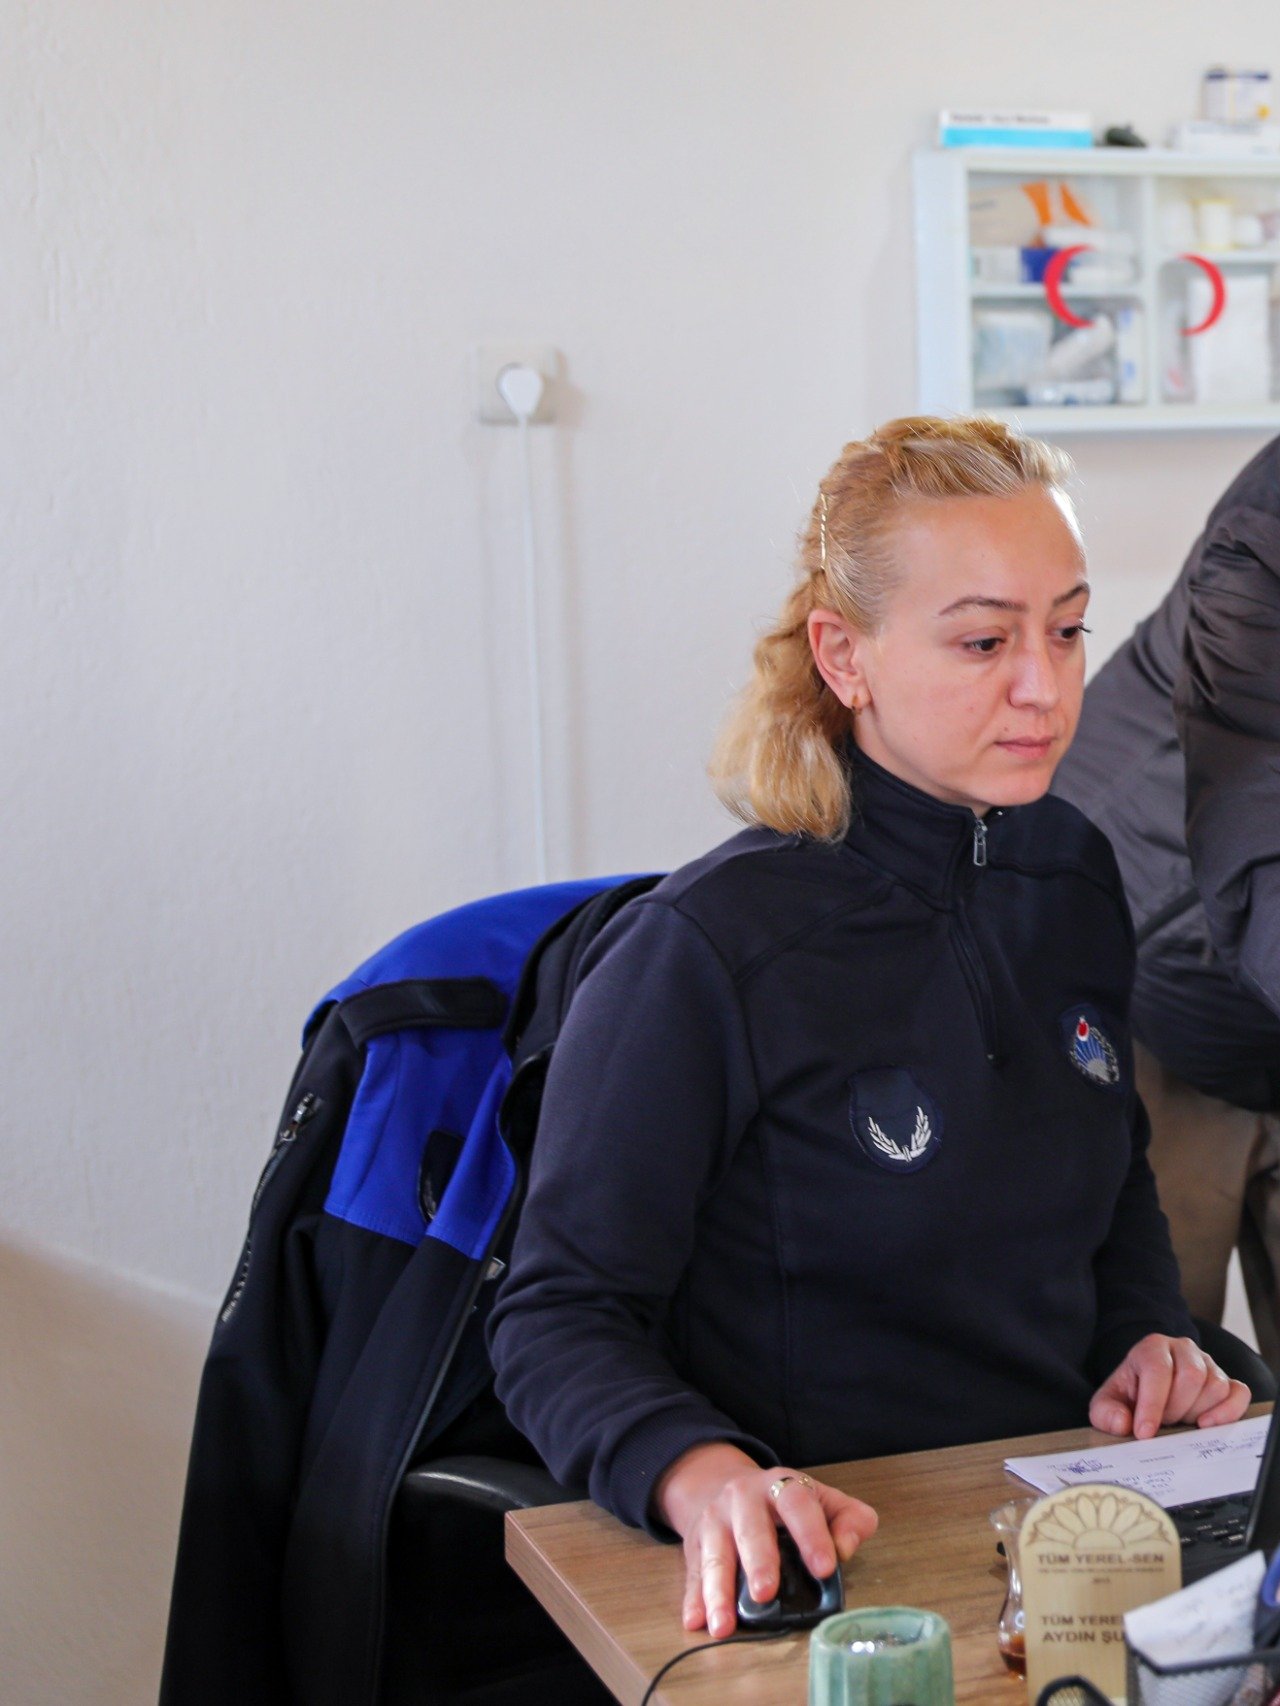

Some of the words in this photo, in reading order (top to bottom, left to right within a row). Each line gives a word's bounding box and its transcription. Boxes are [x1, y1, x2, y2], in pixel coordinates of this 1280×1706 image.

[1038, 1552, 1069, 1564] TÜM
[1041, 1614, 1074, 1625] TÜM
[1078, 1614, 1122, 1625] YERE
[1042, 1630, 1095, 1642] AYDIN
[1101, 1630, 1122, 1644] ŞU
